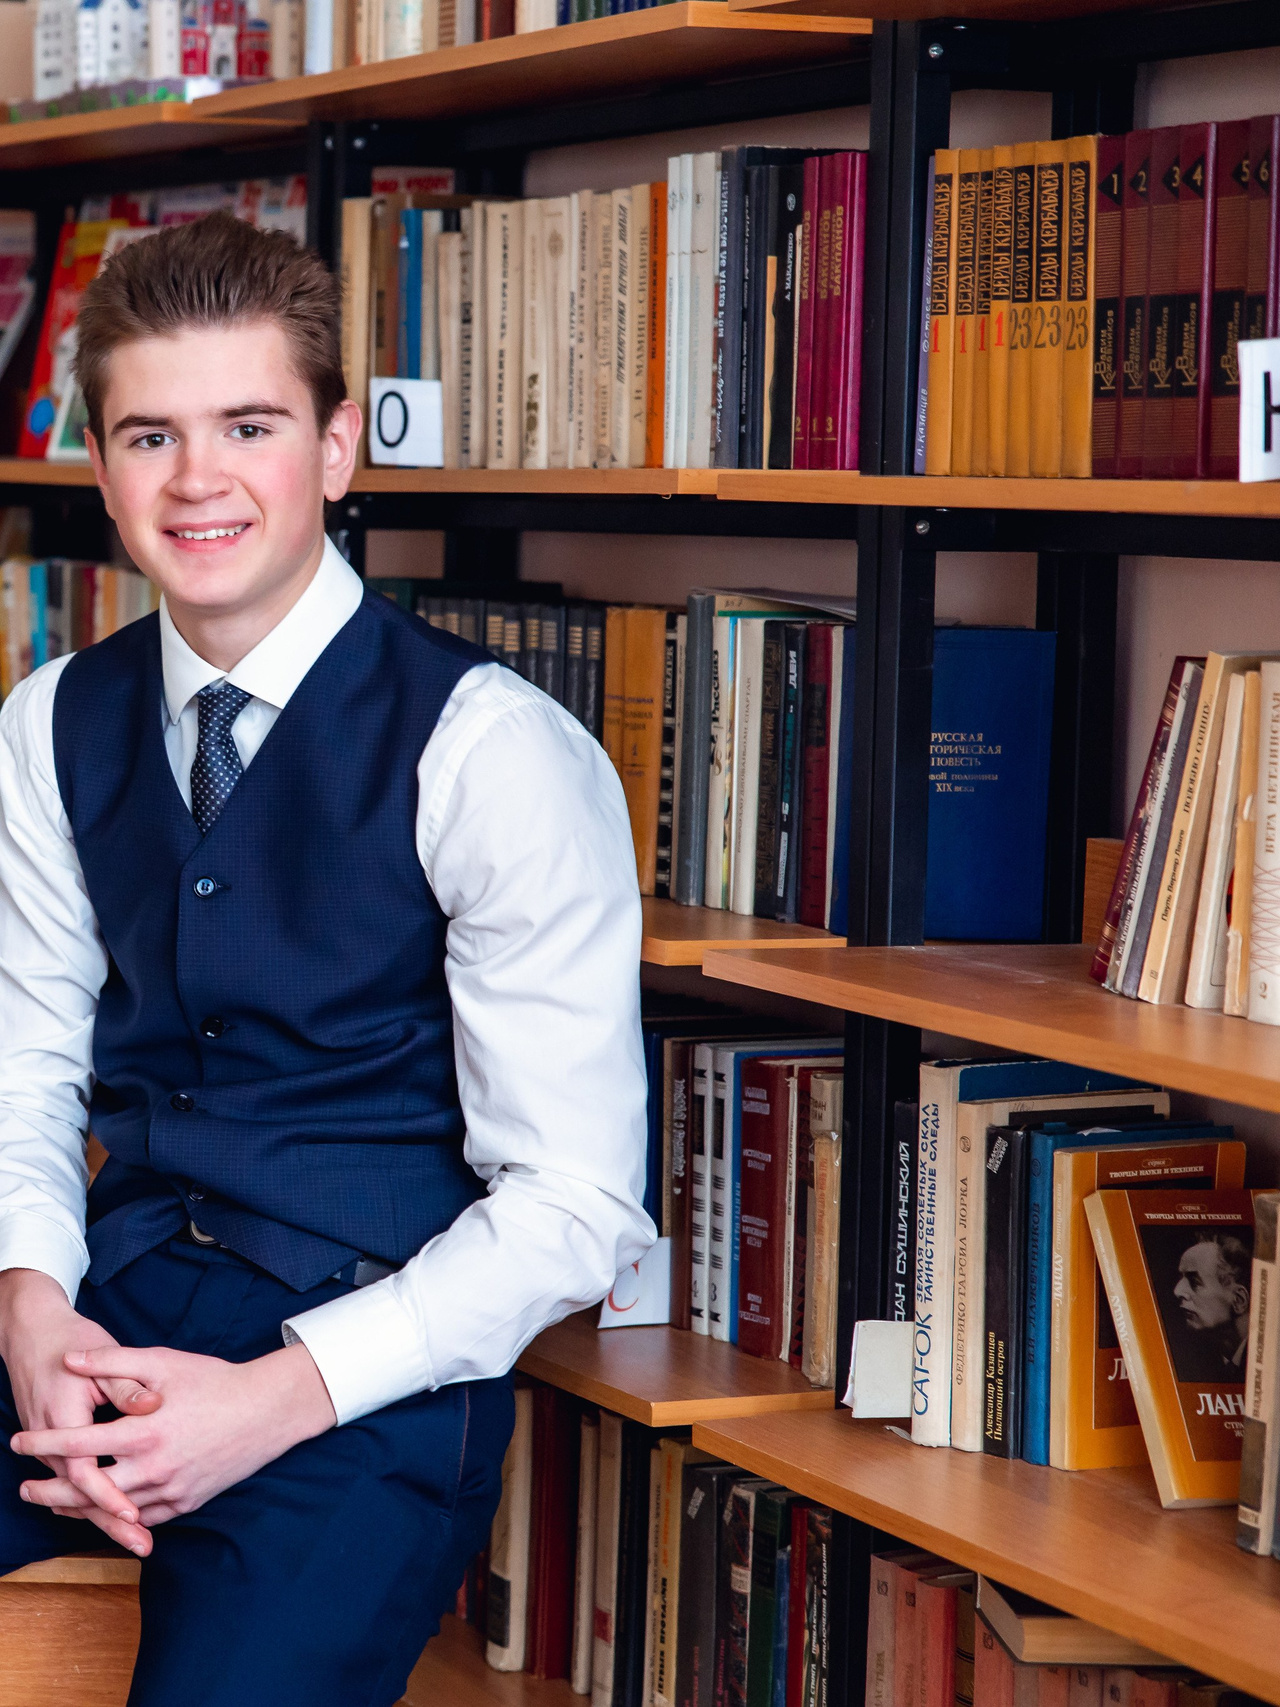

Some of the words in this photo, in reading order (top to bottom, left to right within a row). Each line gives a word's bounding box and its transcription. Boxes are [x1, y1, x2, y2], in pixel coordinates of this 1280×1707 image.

[1111, 173, 1119, 195] 1
[1138, 170, 1146, 192] 2
[1171, 166, 1180, 187] 3
[1192, 165, 1202, 186] 4
[1241, 160, 1250, 182] 5
[933, 183, 950, 257] КЕРБАБАЕВ
[958, 182, 975, 257] КЕРБАБАЕВ
[994, 170, 1012, 247] КЕРБАБАЕВ
[1016, 172, 1031, 249] КЕРБАБАЕВ
[1039, 170, 1059, 247] КЕРБАБАЕВ
[1070, 169, 1087, 246] КЕРБАБАЕВ
[784, 232, 794, 290] МАКАРЕНКО
[820, 209, 830, 299] БАКЛАНОВ
[833, 205, 844, 296] БАКЛАНОВ
[932, 261, 949, 313] БЕРДЫ
[956, 261, 974, 313] БЕРДЫ
[994, 252, 1011, 296] БЕРДЫ
[1015, 254, 1030, 299] БЕРДЫ
[1039, 252, 1058, 297] БЕРДЫ
[1069, 252, 1087, 297] БЕРДЫ
[932, 319, 940, 353] 1
[960, 319, 967, 353] 1
[979, 316, 986, 351] 1
[994, 311, 1004, 347] 1
[930, 746, 1001, 754] ТОРИЧЕСКАЯ
[931, 733, 983, 742] РУССКАЯ
[1266, 691, 1280, 806] КЕТЛИНСКАЯ
[930, 757, 982, 766] ПОВЕСТЬ
[936, 783, 953, 792] XIX
[1182, 756, 1200, 814] ПОДОБНО
[1172, 829, 1185, 857] Ланге
[1264, 813, 1278, 854] ВЕРА
[1125, 826, 1152, 906] Занимательная
[1166, 857, 1182, 893] Вернер
[1120, 909, 1134, 943] Куприн
[1160, 894, 1174, 922] Пауль
[1258, 982, 1268, 1001] 2
[920, 1103, 930, 1153] СКАЛ
[929, 1103, 940, 1162] СЛЕДЫ
[1109, 1170, 1138, 1178] ТВОРЦЫ
[1139, 1168, 1162, 1176] НАУКИ
[1170, 1165, 1204, 1174] ТЕХНИКИ
[895, 1140, 910, 1275] СУШИНСКИЙ
[917, 1160, 927, 1241] СОЛЕНЫХ
[958, 1176, 969, 1230] ЛОРКА
[1144, 1212, 1174, 1220] ТВОРЦЫ
[924, 1168, 937, 1303] ТАИНСТВЕННЫЕ
[915, 1247, 924, 1303] ЗЕМЛЯ
[1028, 1202, 1040, 1328] ЛАЖЕЧНИКОВ
[1053, 1250, 1064, 1305] ЛАНДАУ
[894, 1284, 906, 1322] ДАН
[912, 1313, 933, 1416] САТ-ОК
[955, 1303, 967, 1386] ФЕДЕРИКО
[986, 1331, 996, 1379] Казанцев
[996, 1340, 1005, 1376] остров
[985, 1382, 995, 1439] Александр
[994, 1377, 1005, 1441] Пылающий
[1196, 1393, 1246, 1416] ЛАН
[1224, 1421, 1245, 1429] СТРА
